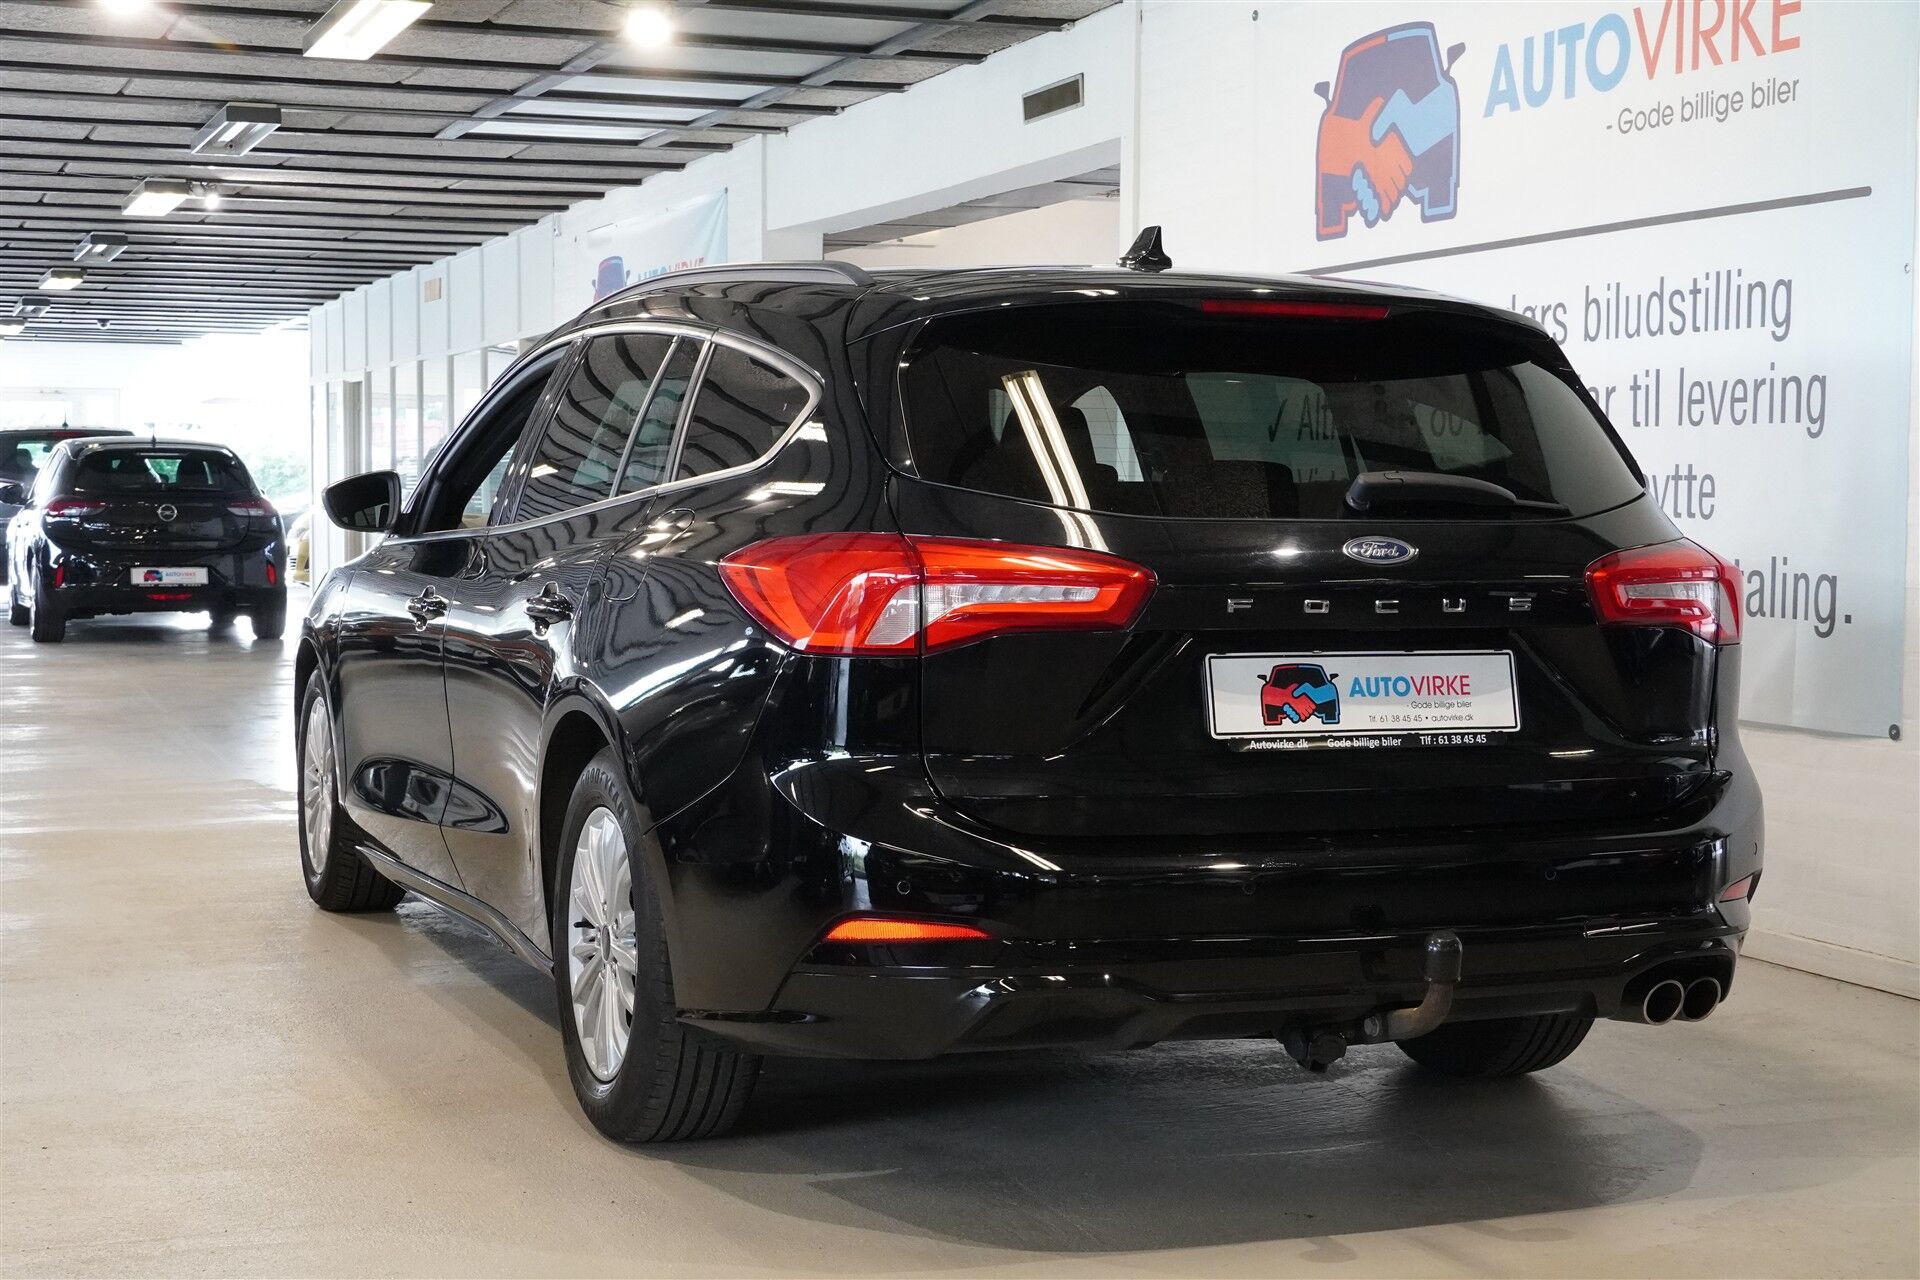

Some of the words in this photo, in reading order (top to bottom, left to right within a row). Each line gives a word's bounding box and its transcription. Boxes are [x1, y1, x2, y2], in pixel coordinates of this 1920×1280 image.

[1483, 0, 1801, 119] AUTOVIRKE
[1618, 101, 1674, 134] Gode
[1680, 90, 1744, 123] billige
[1751, 77, 1800, 109] biler
[1583, 269, 1793, 342] biludstilling
[1630, 368, 1661, 428] til
[1677, 362, 1827, 439] levering
[1643, 463, 1716, 520] ytte
[1361, 541, 1400, 558] Ford
[1227, 597, 1533, 614] FOCUS
[1734, 556, 1852, 638] aling.
[1349, 675, 1471, 697] AUTOVIRKE
[1411, 701, 1432, 709] Gode
[1413, 714, 1422, 722] 45
[1327, 738, 1351, 748] Gode
[1353, 737, 1379, 748] billige
[1382, 736, 1402, 746] biler
[1438, 735, 1449, 744] 61
[1451, 735, 1461, 744] 38
[1464, 735, 1474, 743] 45
[1476, 735, 1487, 743] 45
